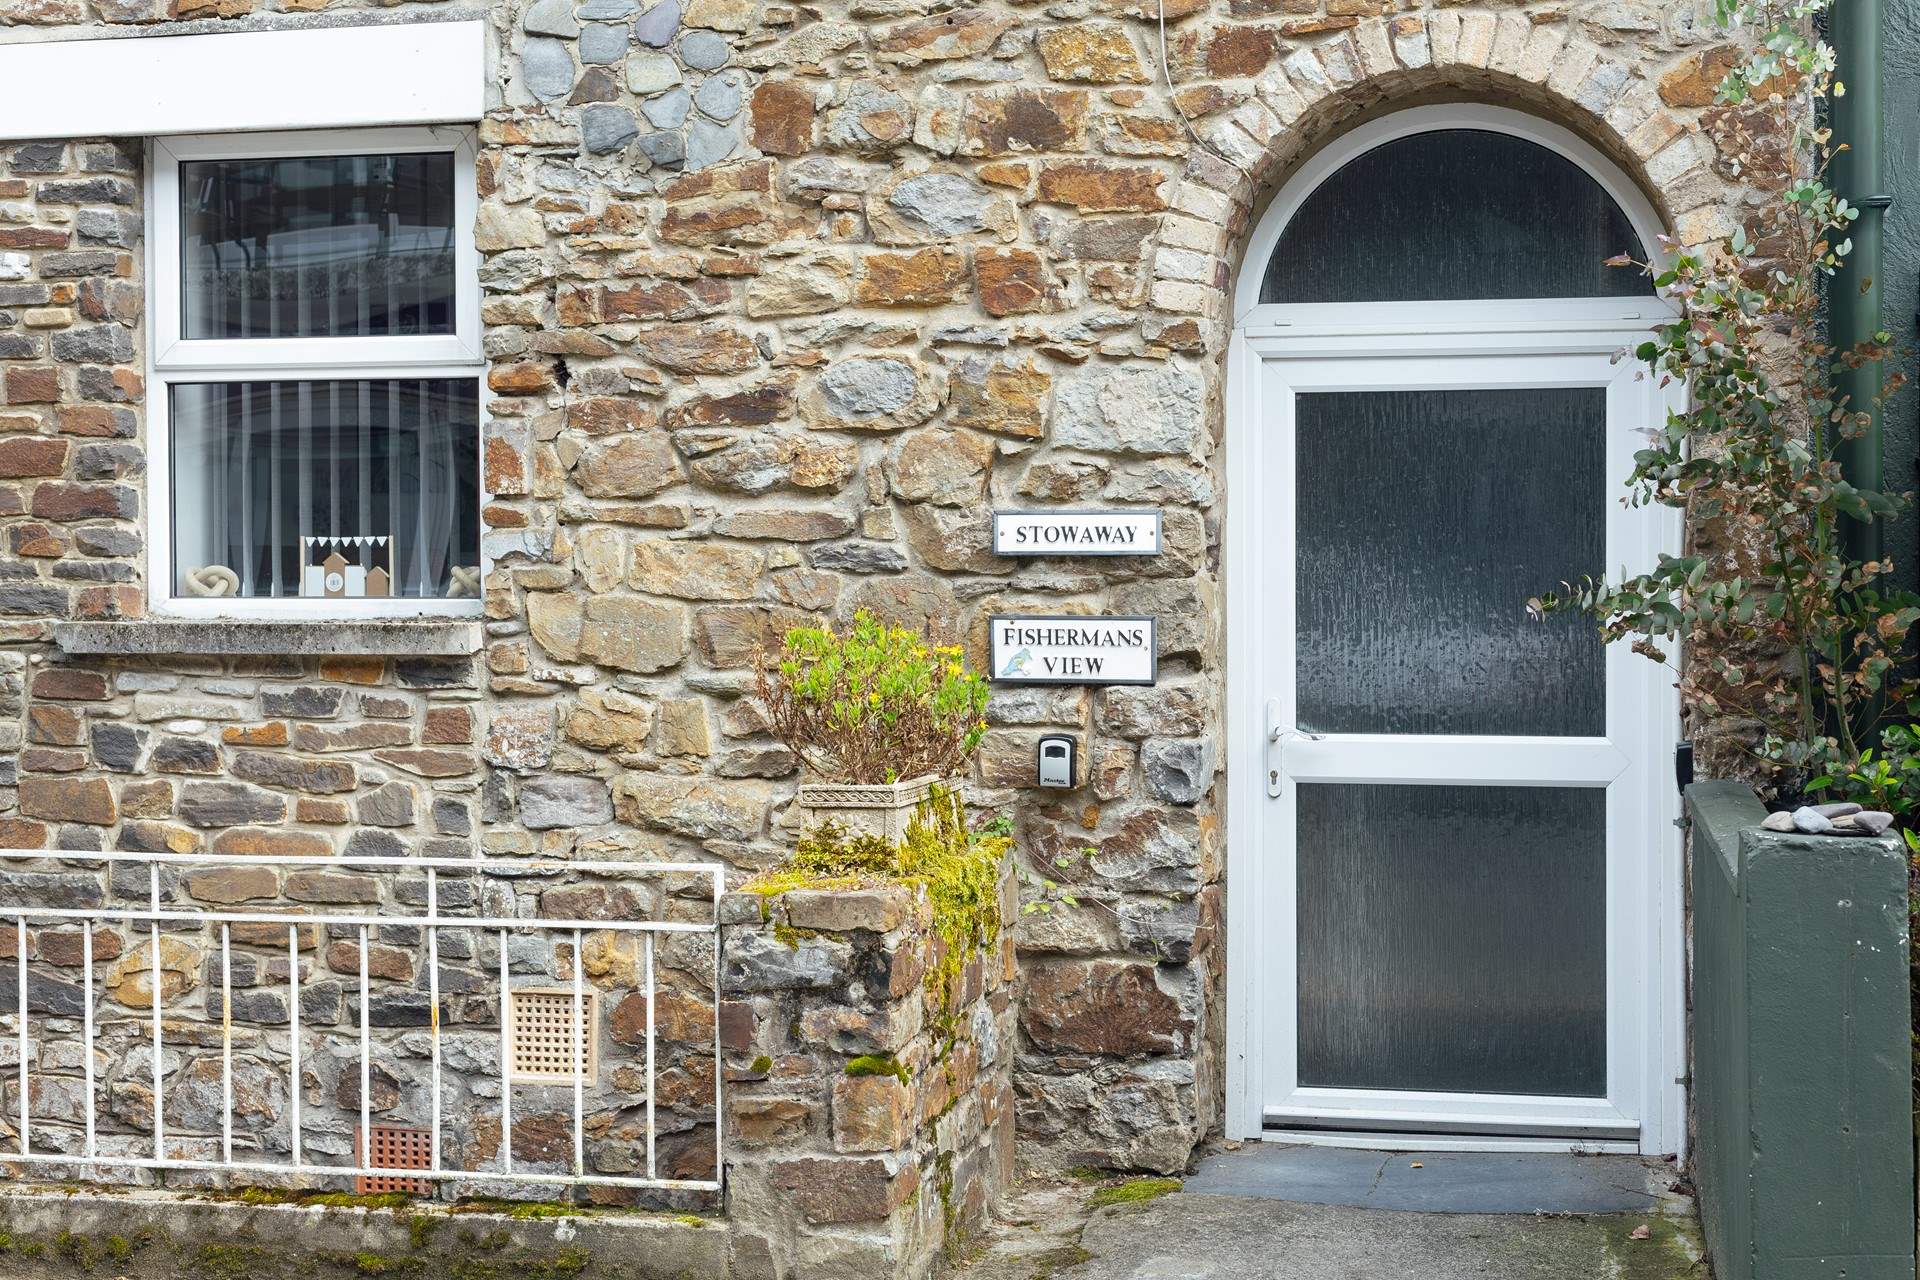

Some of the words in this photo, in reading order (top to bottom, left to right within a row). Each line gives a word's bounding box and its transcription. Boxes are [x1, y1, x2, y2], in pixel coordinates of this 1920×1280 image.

[1016, 525, 1138, 544] STOWAWAY
[1004, 627, 1144, 648] FISHERMANS
[1043, 656, 1105, 675] VIEW
